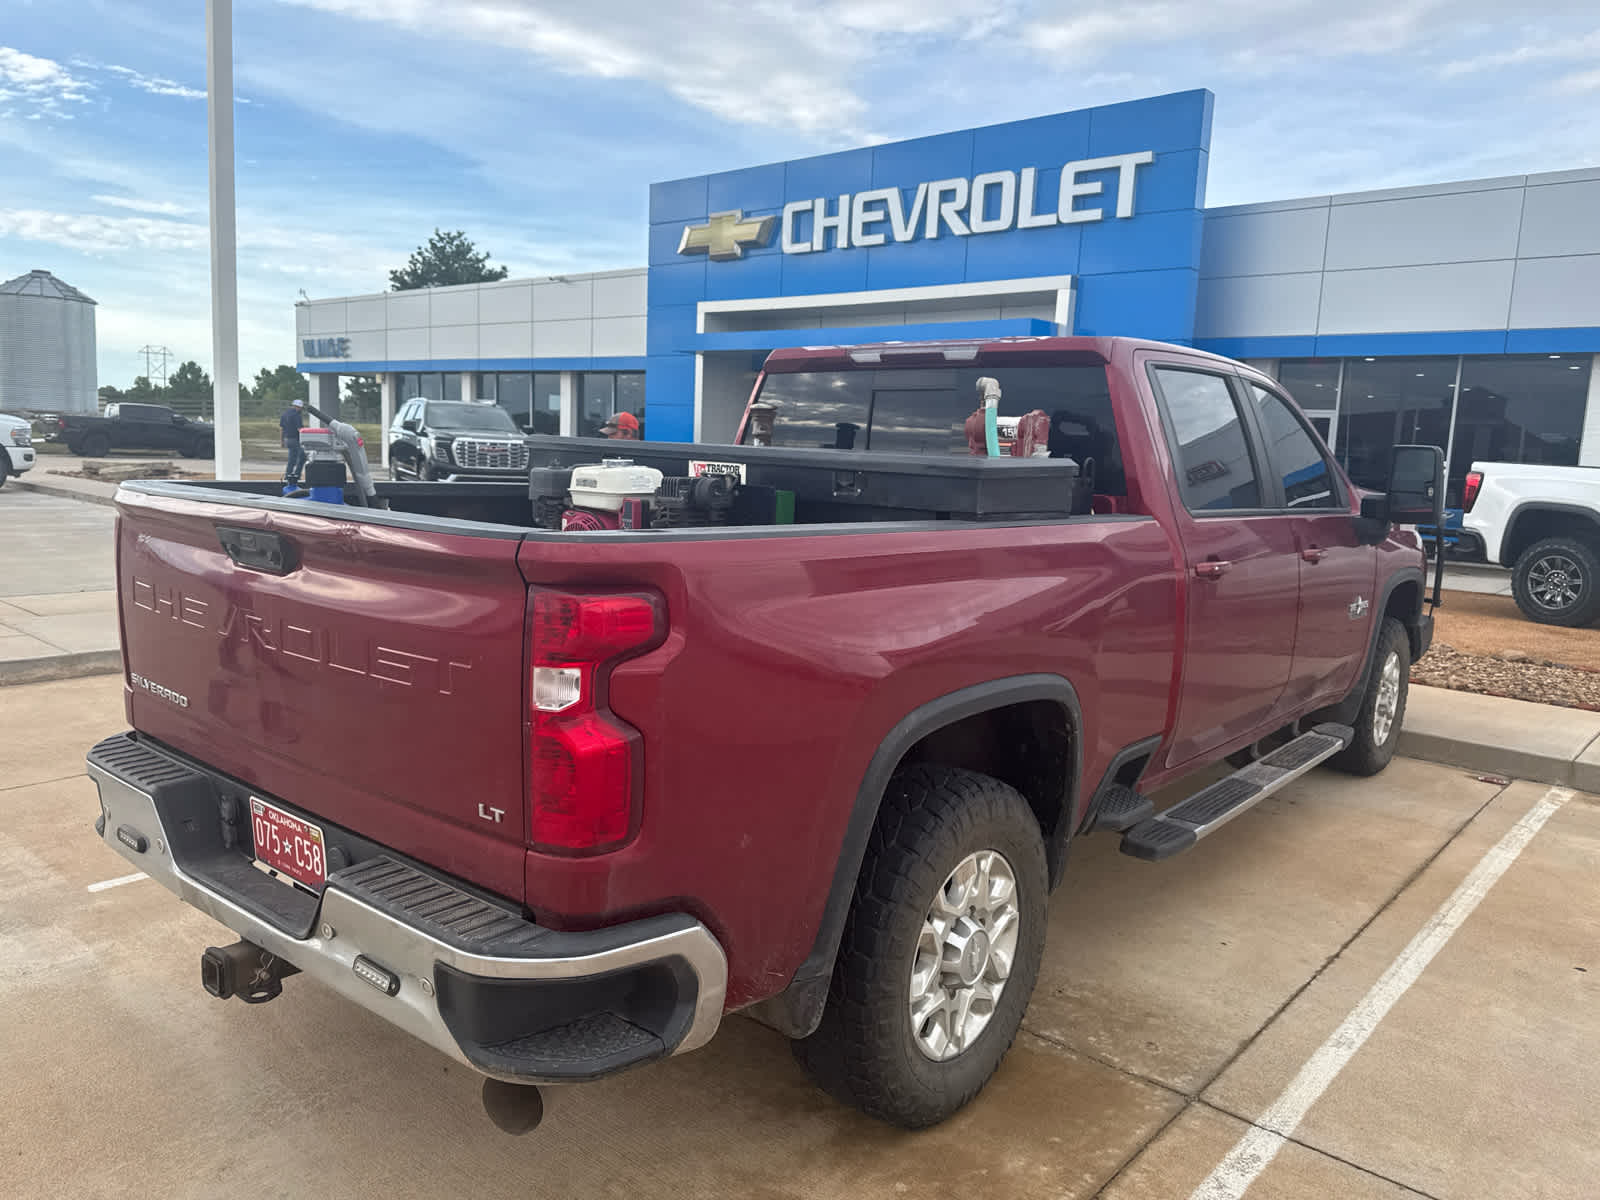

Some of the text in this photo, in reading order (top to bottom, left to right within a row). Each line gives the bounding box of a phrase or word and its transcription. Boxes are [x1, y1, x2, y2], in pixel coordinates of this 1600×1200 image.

[781, 150, 1154, 255] CHEVROLET
[706, 463, 740, 475] TRACTOR
[133, 576, 472, 694] CHEVROLET
[130, 672, 188, 707] SILVERADO
[268, 810, 303, 833] OKLAHOMA
[478, 803, 505, 823] LT
